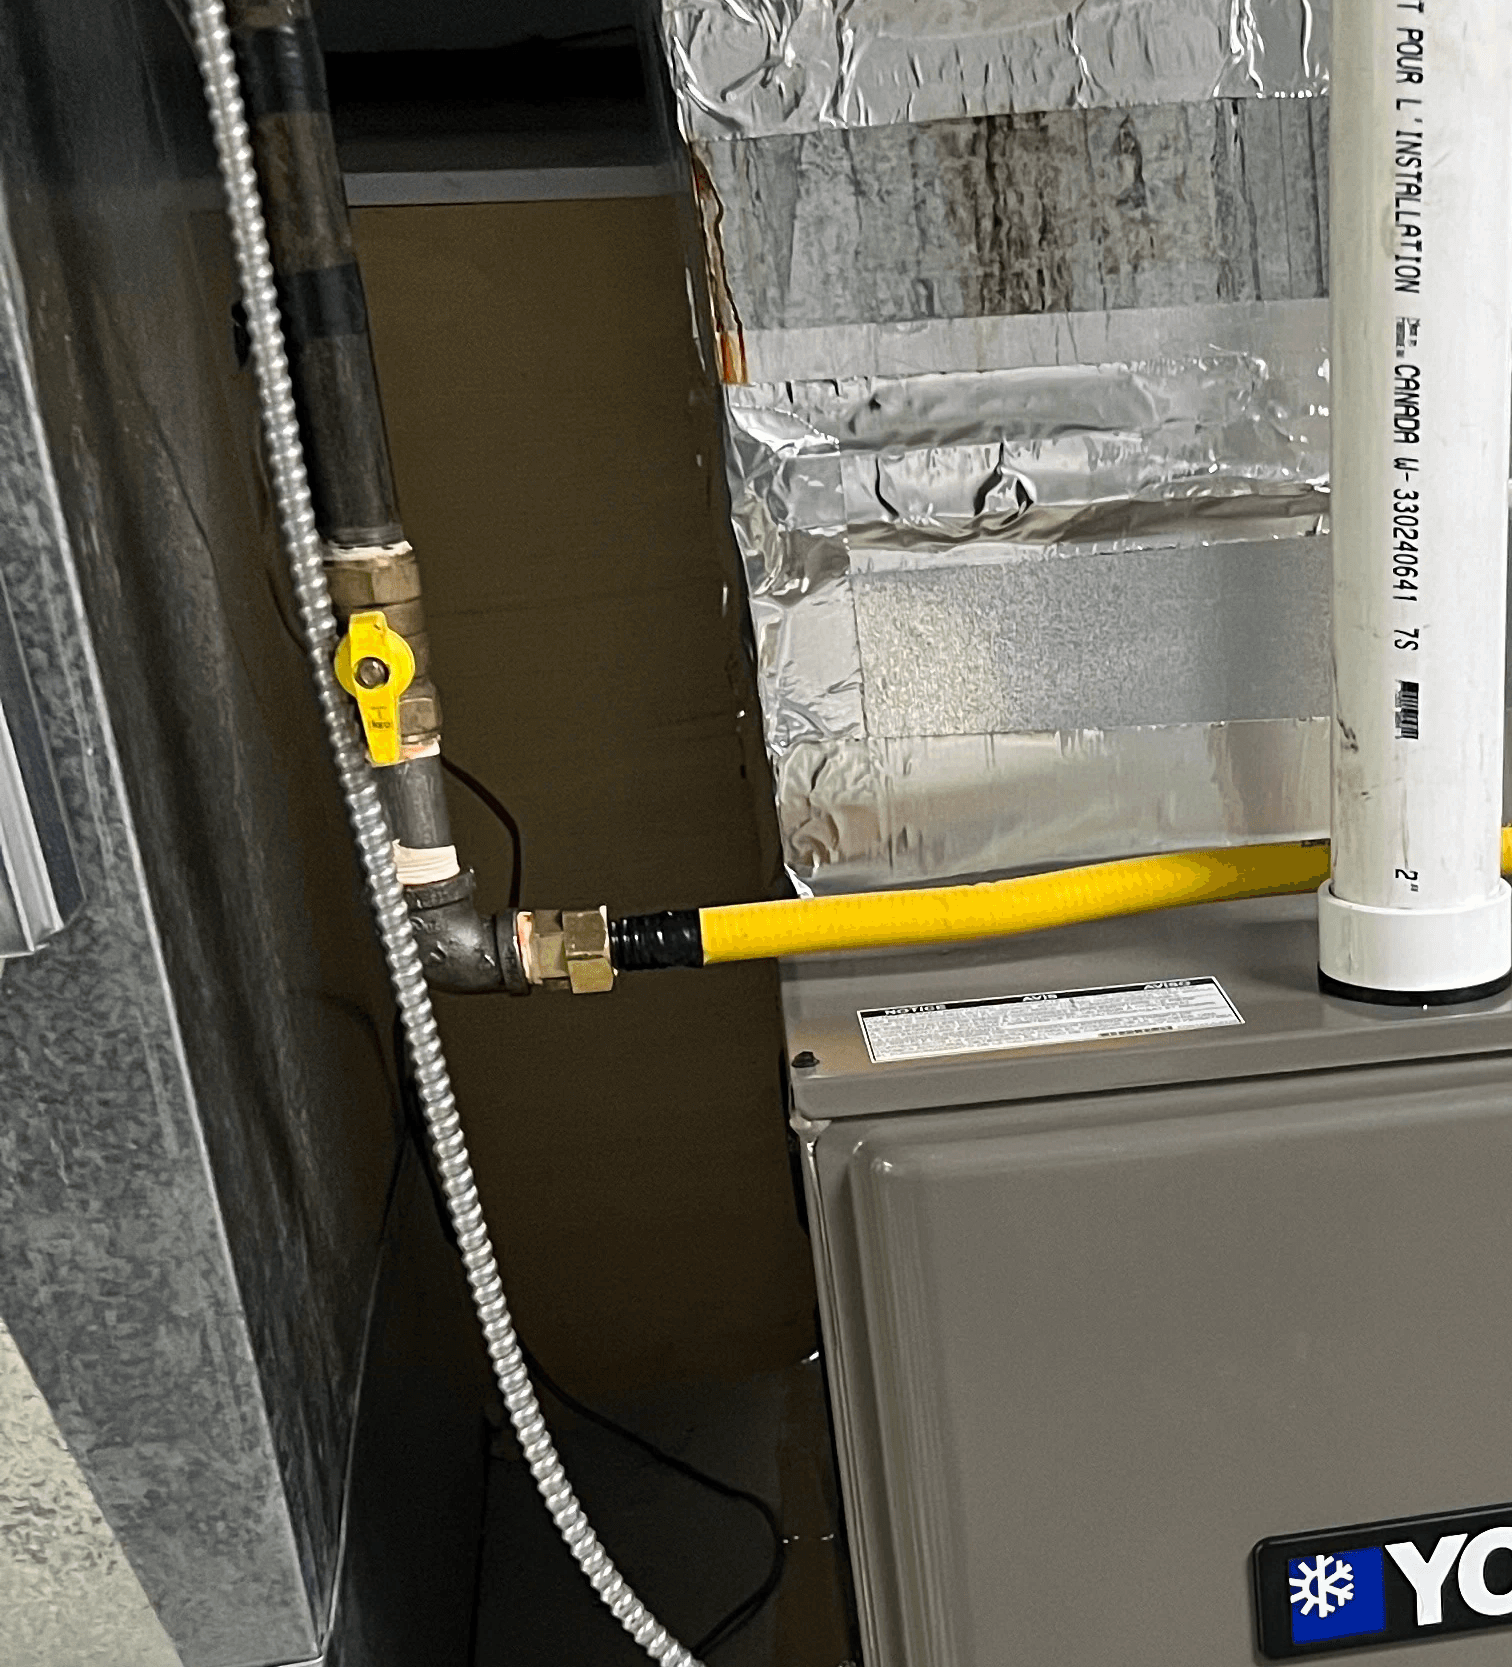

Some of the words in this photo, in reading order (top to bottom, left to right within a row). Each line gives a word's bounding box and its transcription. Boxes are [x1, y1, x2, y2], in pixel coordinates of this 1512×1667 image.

[1396, 27, 1424, 84] POUR
[1393, 364, 1422, 444] CANADA
[1393, 629, 1420, 651] 7S
[1022, 992, 1058, 1002] AVIS
[884, 1003, 947, 1016] NOTICE
